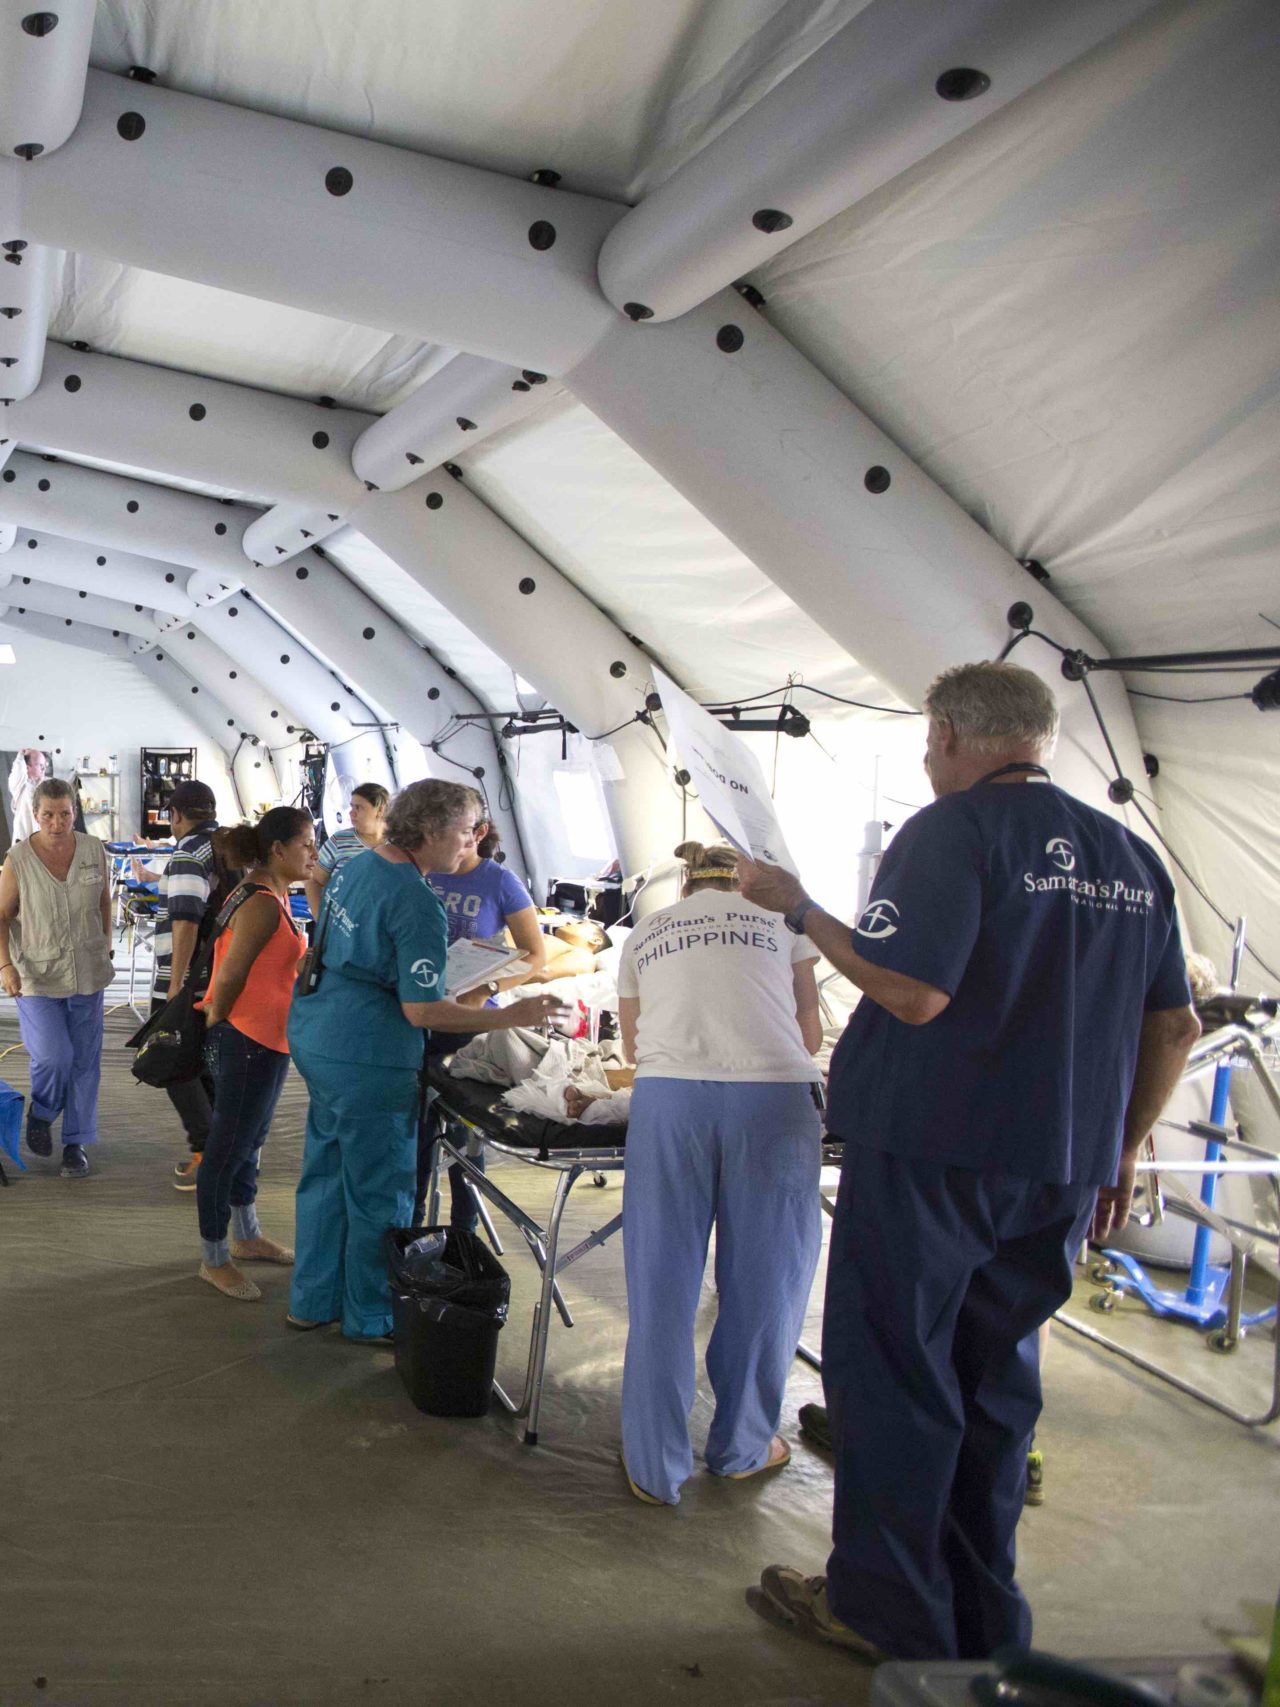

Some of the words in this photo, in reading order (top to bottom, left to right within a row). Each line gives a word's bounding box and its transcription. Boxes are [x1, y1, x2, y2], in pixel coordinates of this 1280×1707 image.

[634, 914, 715, 955] Samaritan's
[726, 912, 776, 928] Purse
[637, 931, 779, 974] PHILIPPINES
